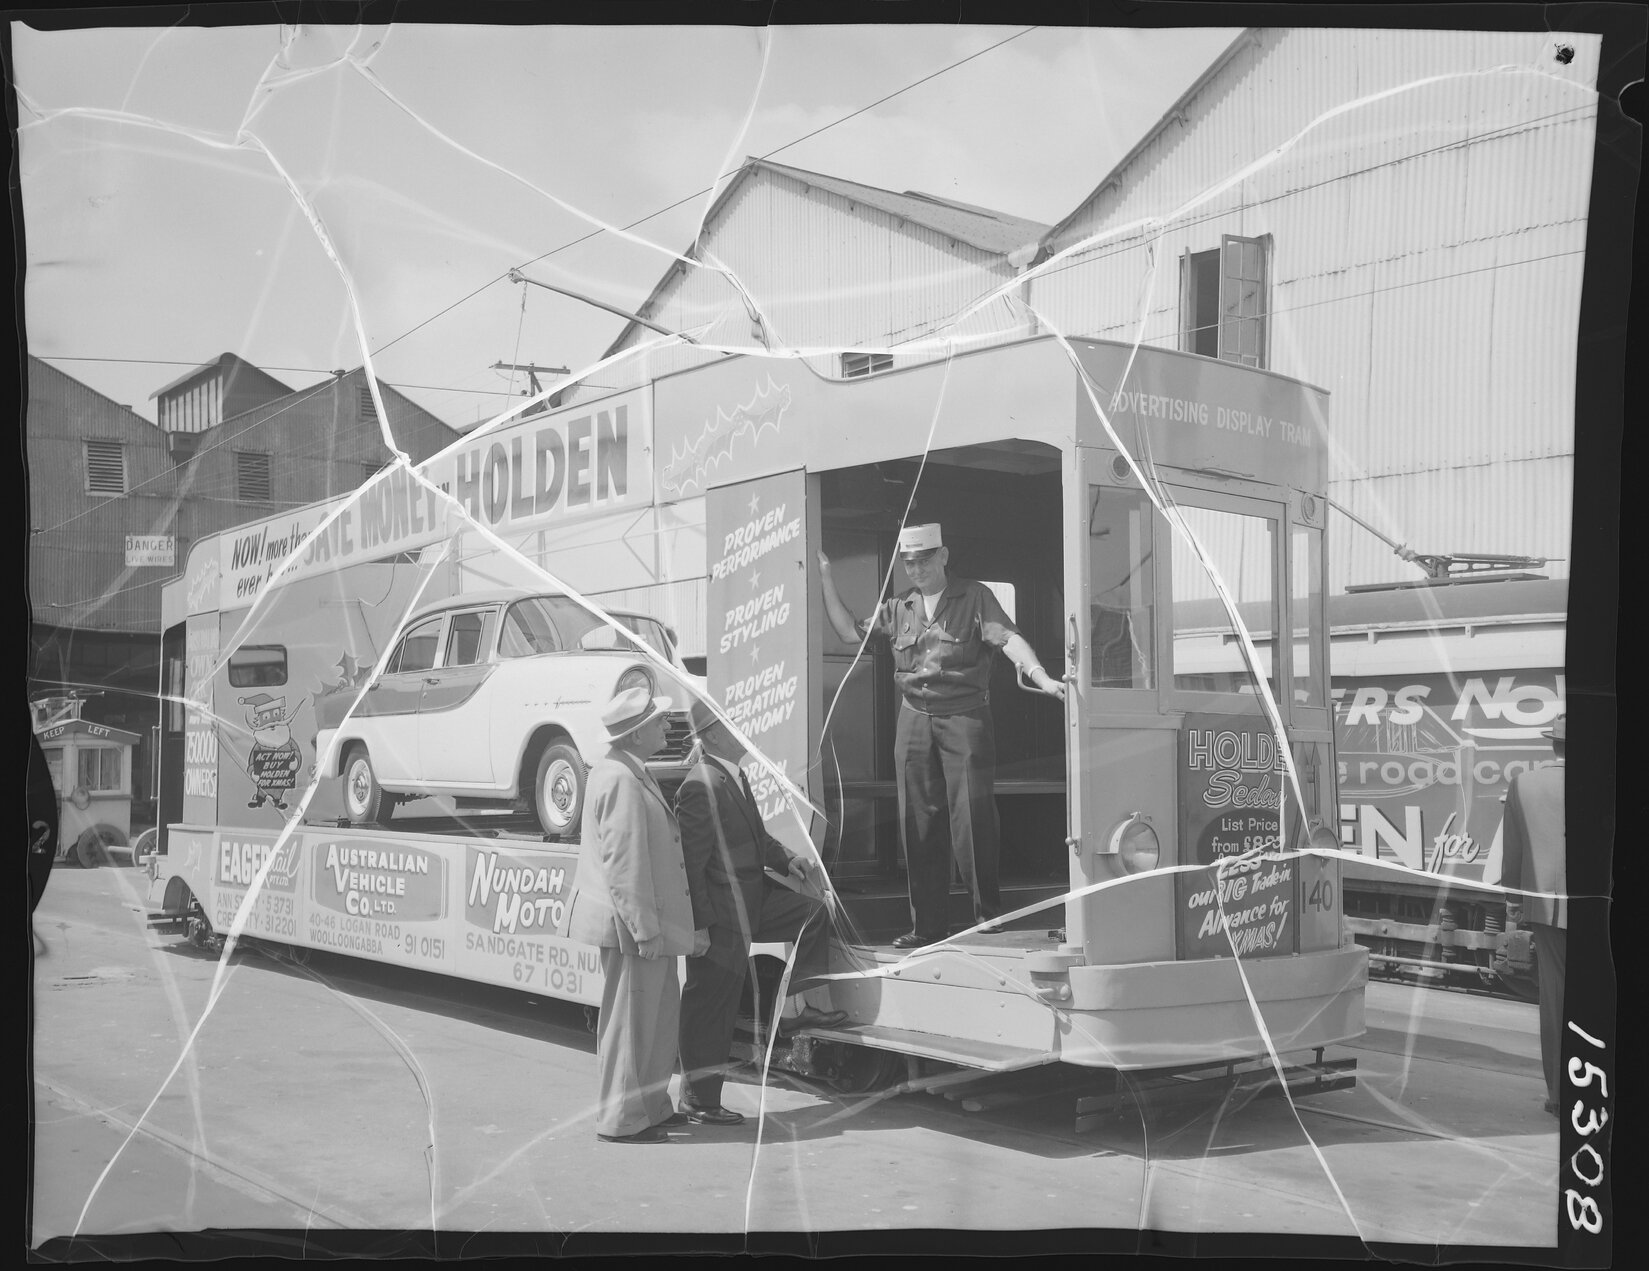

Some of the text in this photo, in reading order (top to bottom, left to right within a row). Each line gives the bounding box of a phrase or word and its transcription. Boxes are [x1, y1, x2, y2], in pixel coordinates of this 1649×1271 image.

[1108, 391, 1311, 448] ADVERTISING DISPLAY TRAM
[231, 526, 268, 571] NOW!
[266, 536, 288, 562] more
[457, 404, 628, 525] HOLDEN
[126, 540, 173, 551] DANGER
[724, 503, 786, 556] PROVEN
[126, 555, 173, 563] LIVE WIRES
[711, 517, 801, 584] PERFORMANCE
[236, 573, 262, 599] ever
[724, 584, 785, 631] PROVEN
[720, 602, 790, 655] STYLING
[724, 660, 785, 706] PROVEN
[725, 675, 798, 723] PERATING
[43, 724, 111, 740] KEEP LEFT
[740, 700, 795, 739] ONOMY
[255, 751, 294, 761] ACT NOW!
[262, 760, 284, 769] BUY
[1188, 729, 1291, 774] HOLDE
[257, 779, 272, 787] FOR
[260, 769, 291, 778] HOLDEN
[1359, 751, 1462, 785] road
[1203, 769, 1288, 808] Sedan
[31, 820, 50, 854] 2
[1222, 817, 1278, 831] List Price
[1211, 836, 1239, 852] from
[1426, 811, 1481, 874] for
[325, 843, 429, 875] AUSTRALIAN
[334, 866, 405, 896] VEHICLE
[468, 851, 566, 907] NUNDAH
[1188, 889, 1218, 909] our
[1218, 876, 1248, 903] BIG
[217, 892, 232, 909] ANN
[373, 901, 397, 914] LTD.
[1302, 880, 1333, 914] 140
[216, 910, 237, 928] CRE
[310, 913, 400, 940] 40-46 LOGAN ROAD
[1197, 895, 1290, 939] Allwance for
[310, 928, 445, 959] WOOLLOONGABBA 91 0151
[466, 931, 544, 963] SANDGATE
[513, 962, 582, 994] 67 1031
[1564, 1021, 1609, 1235] 15308
